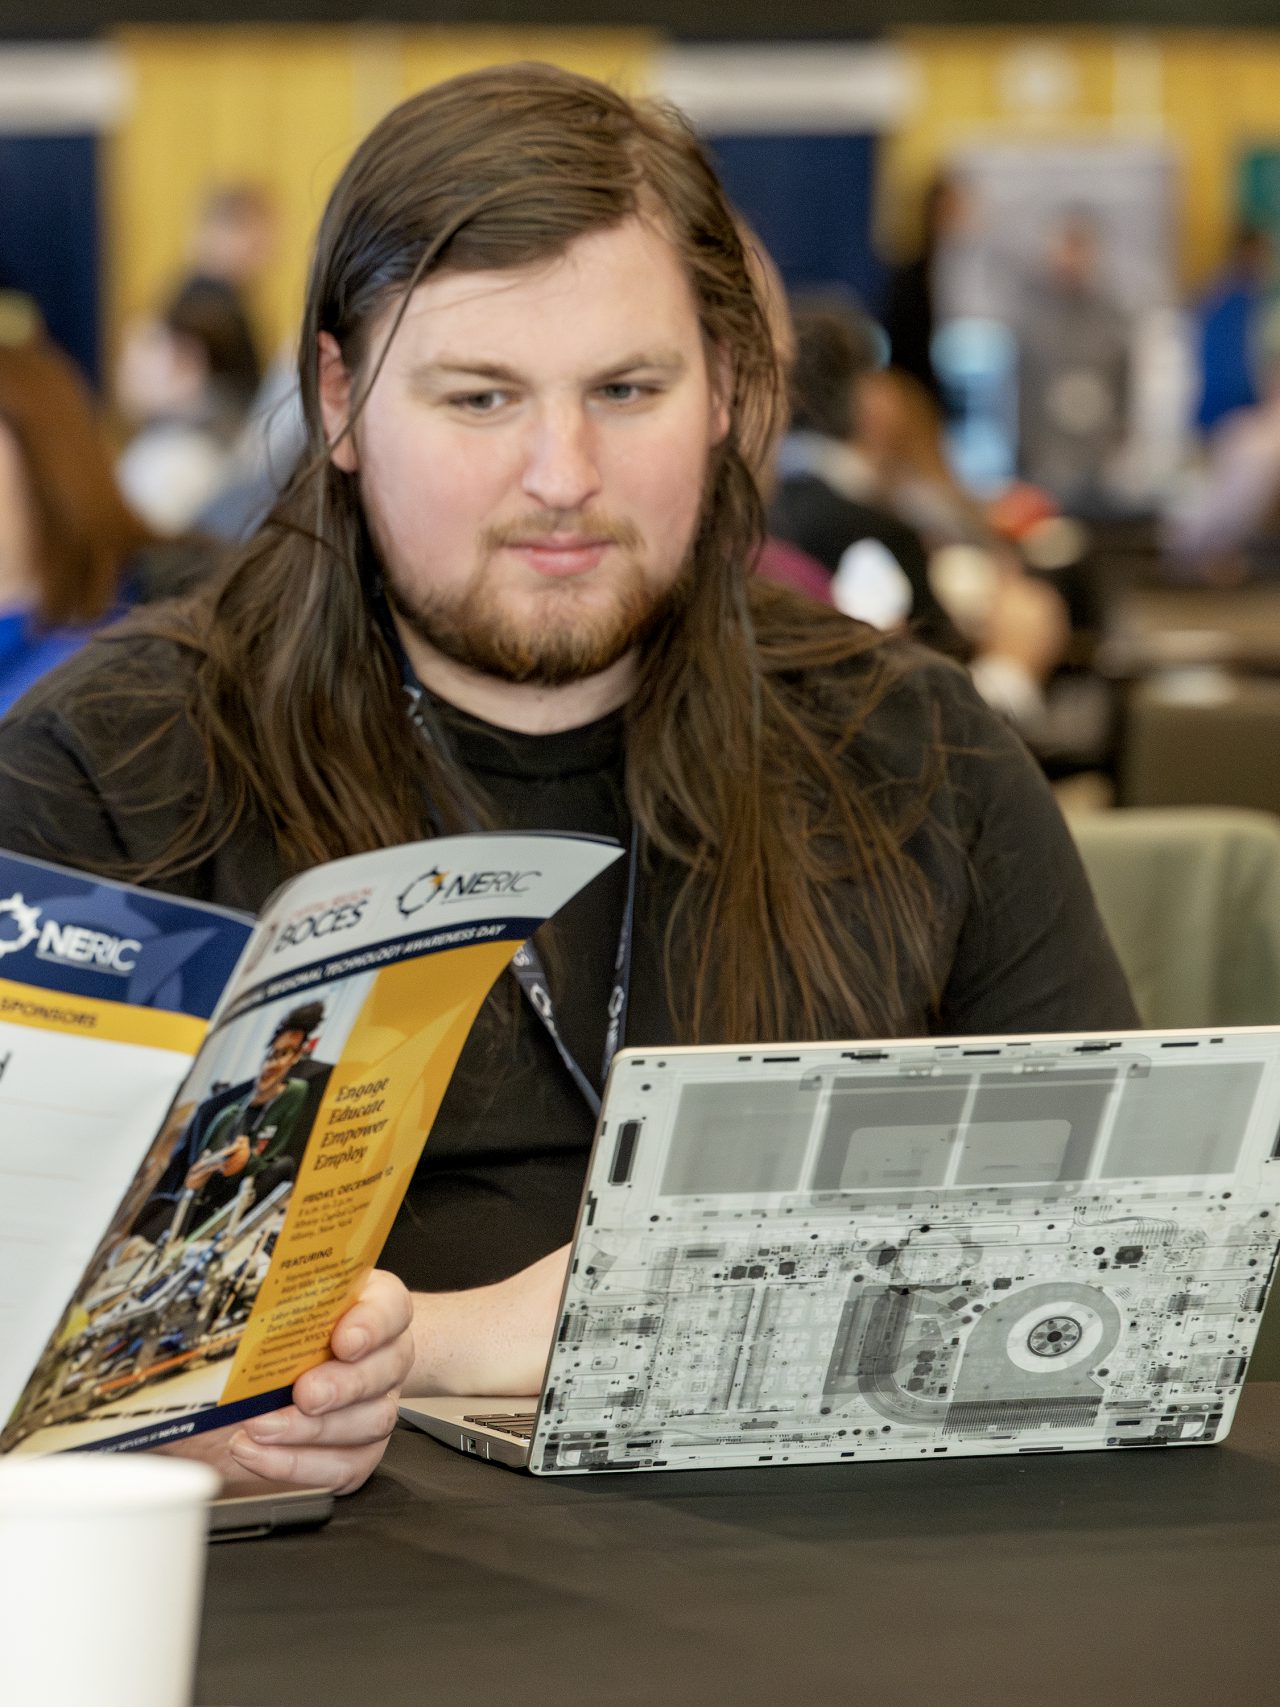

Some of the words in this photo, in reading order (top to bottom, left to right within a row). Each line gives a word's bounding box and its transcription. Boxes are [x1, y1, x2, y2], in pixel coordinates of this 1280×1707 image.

[444, 870, 543, 897] NERIC
[274, 898, 369, 954] BOCES
[401, 927, 476, 956] AWARENESS
[476, 924, 507, 939] DAY
[36, 919, 143, 972] NERIC
[0, 997, 98, 1028] SPONSORS
[336, 1077, 390, 1102] Engage
[328, 1099, 386, 1125] Educate
[320, 1118, 390, 1149] Empower
[313, 1145, 369, 1171] Employ
[280, 1246, 334, 1270] FEATURING
